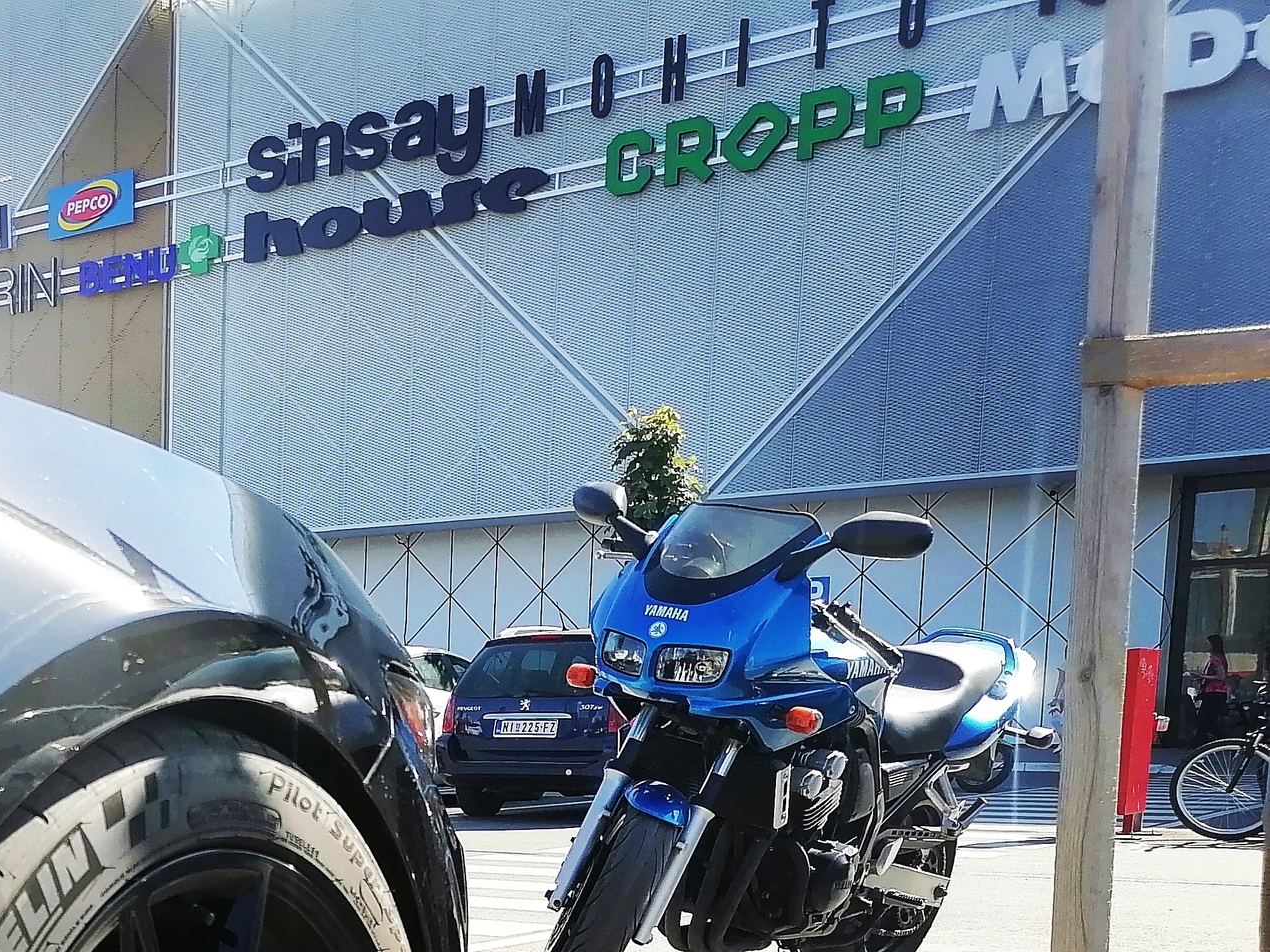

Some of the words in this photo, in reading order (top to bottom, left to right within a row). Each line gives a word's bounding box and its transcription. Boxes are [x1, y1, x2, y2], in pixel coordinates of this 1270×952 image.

[514, 0, 925, 137] MOHITO
[966, 9, 1270, 132] MD
[246, 86, 485, 193] sinsay
[605, 70, 924, 196] CROPP
[66, 193, 109, 217] PEPCO
[243, 166, 550, 264] house
[79, 244, 177, 297] BENU
[644, 604, 690, 622] YAMAHA
[267, 771, 323, 822] Pilot
